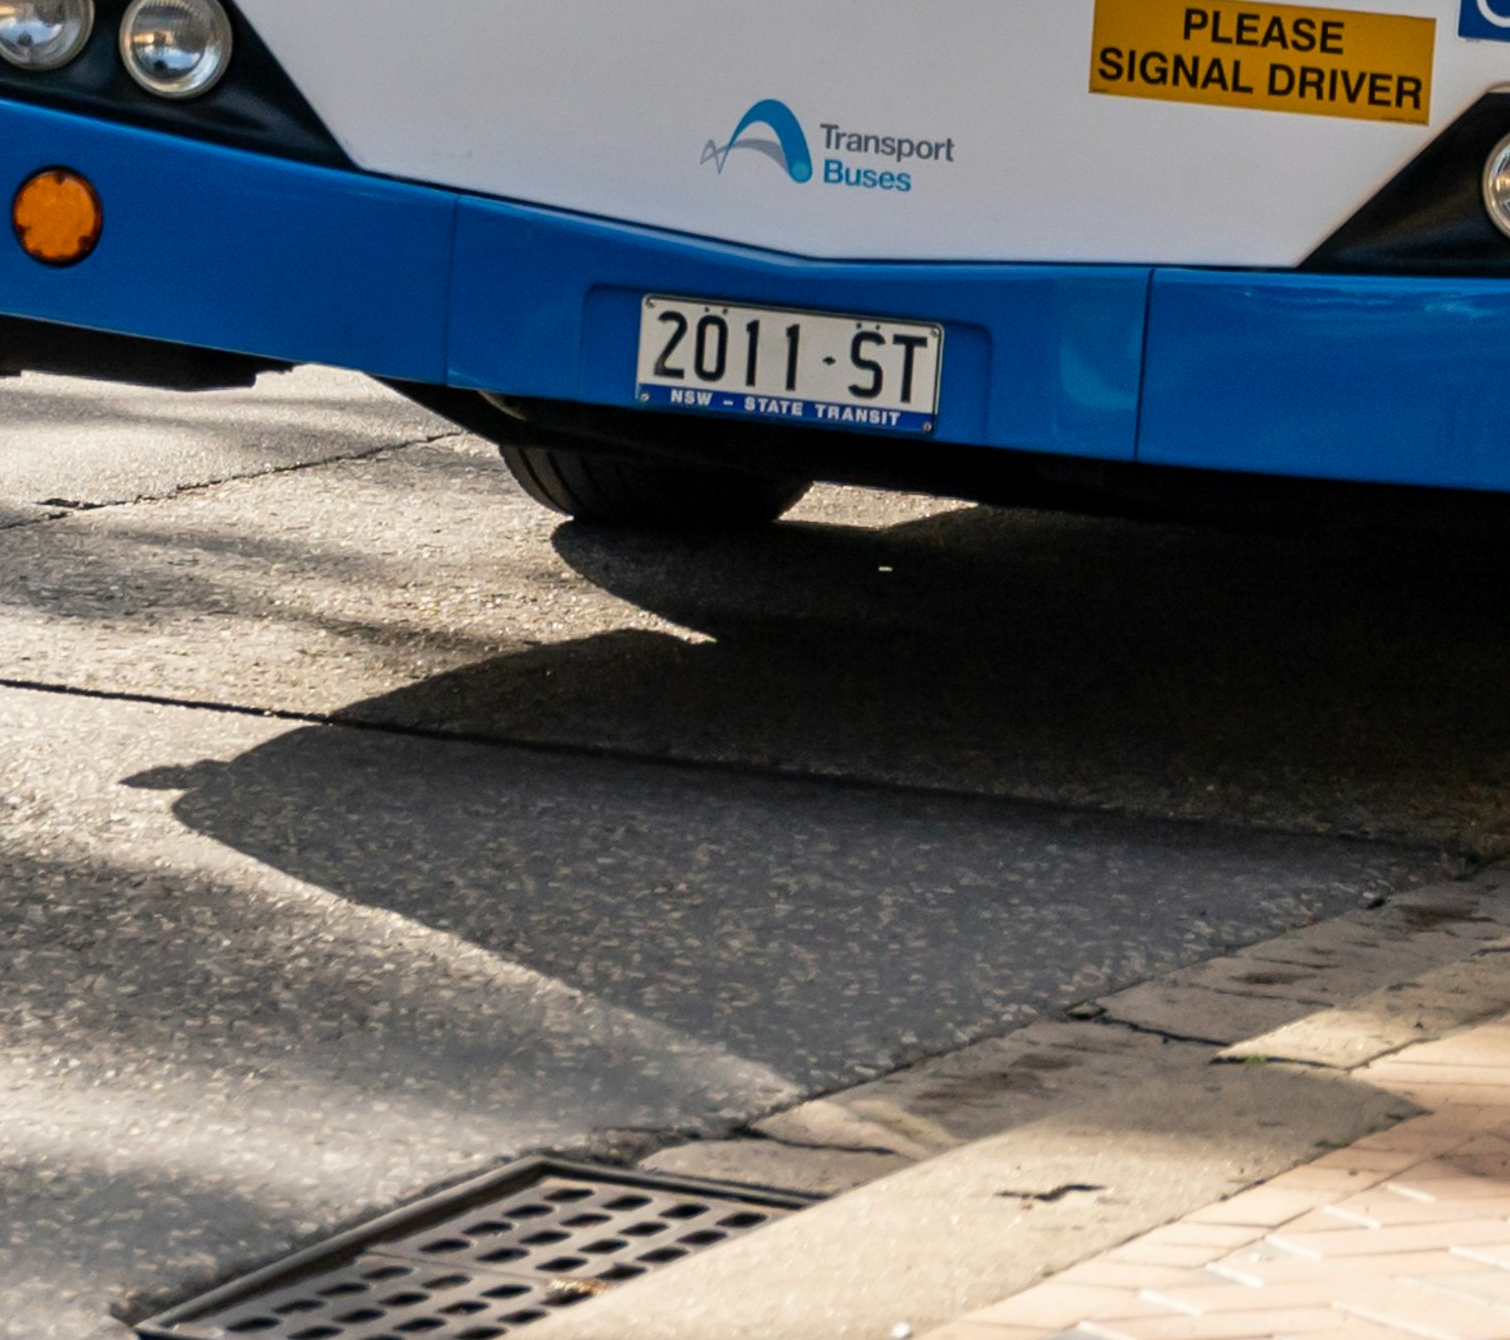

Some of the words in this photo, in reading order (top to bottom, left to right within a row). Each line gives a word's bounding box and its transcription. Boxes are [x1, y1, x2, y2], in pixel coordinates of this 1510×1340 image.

[1183, 7, 1345, 55] PLEASE
[1097, 46, 1254, 95] SIGNAL
[1267, 62, 1423, 110] DRIVER
[819, 123, 956, 162] Transport
[823, 158, 913, 192] Buses
[669, 389, 714, 406] NSW
[744, 396, 804, 417] STATE
[814, 403, 902, 427] TRANSIT
